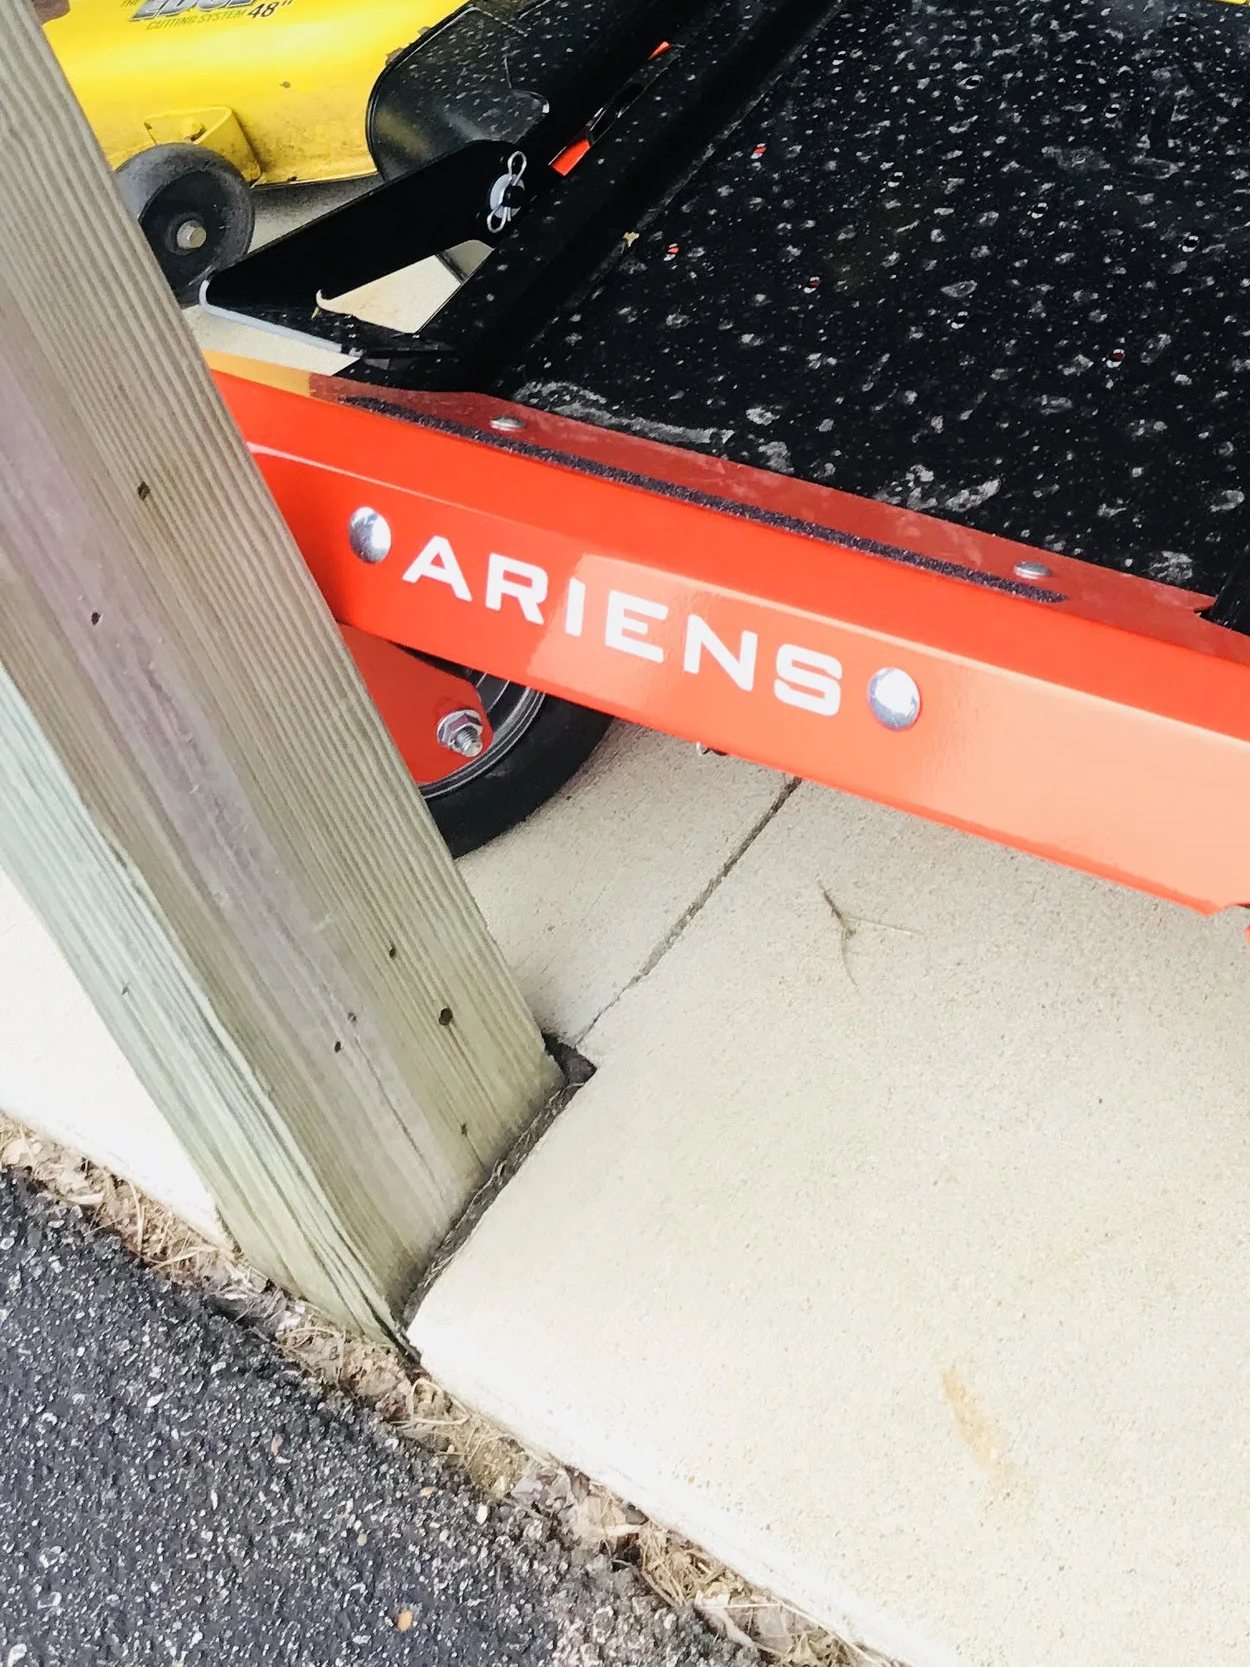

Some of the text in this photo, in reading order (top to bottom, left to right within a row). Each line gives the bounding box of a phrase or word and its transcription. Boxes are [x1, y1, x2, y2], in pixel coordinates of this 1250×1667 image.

[146, 15, 195, 30] CUTTING
[198, 10, 248, 24] SYSTEM
[402, 535, 842, 716] ARIENS
